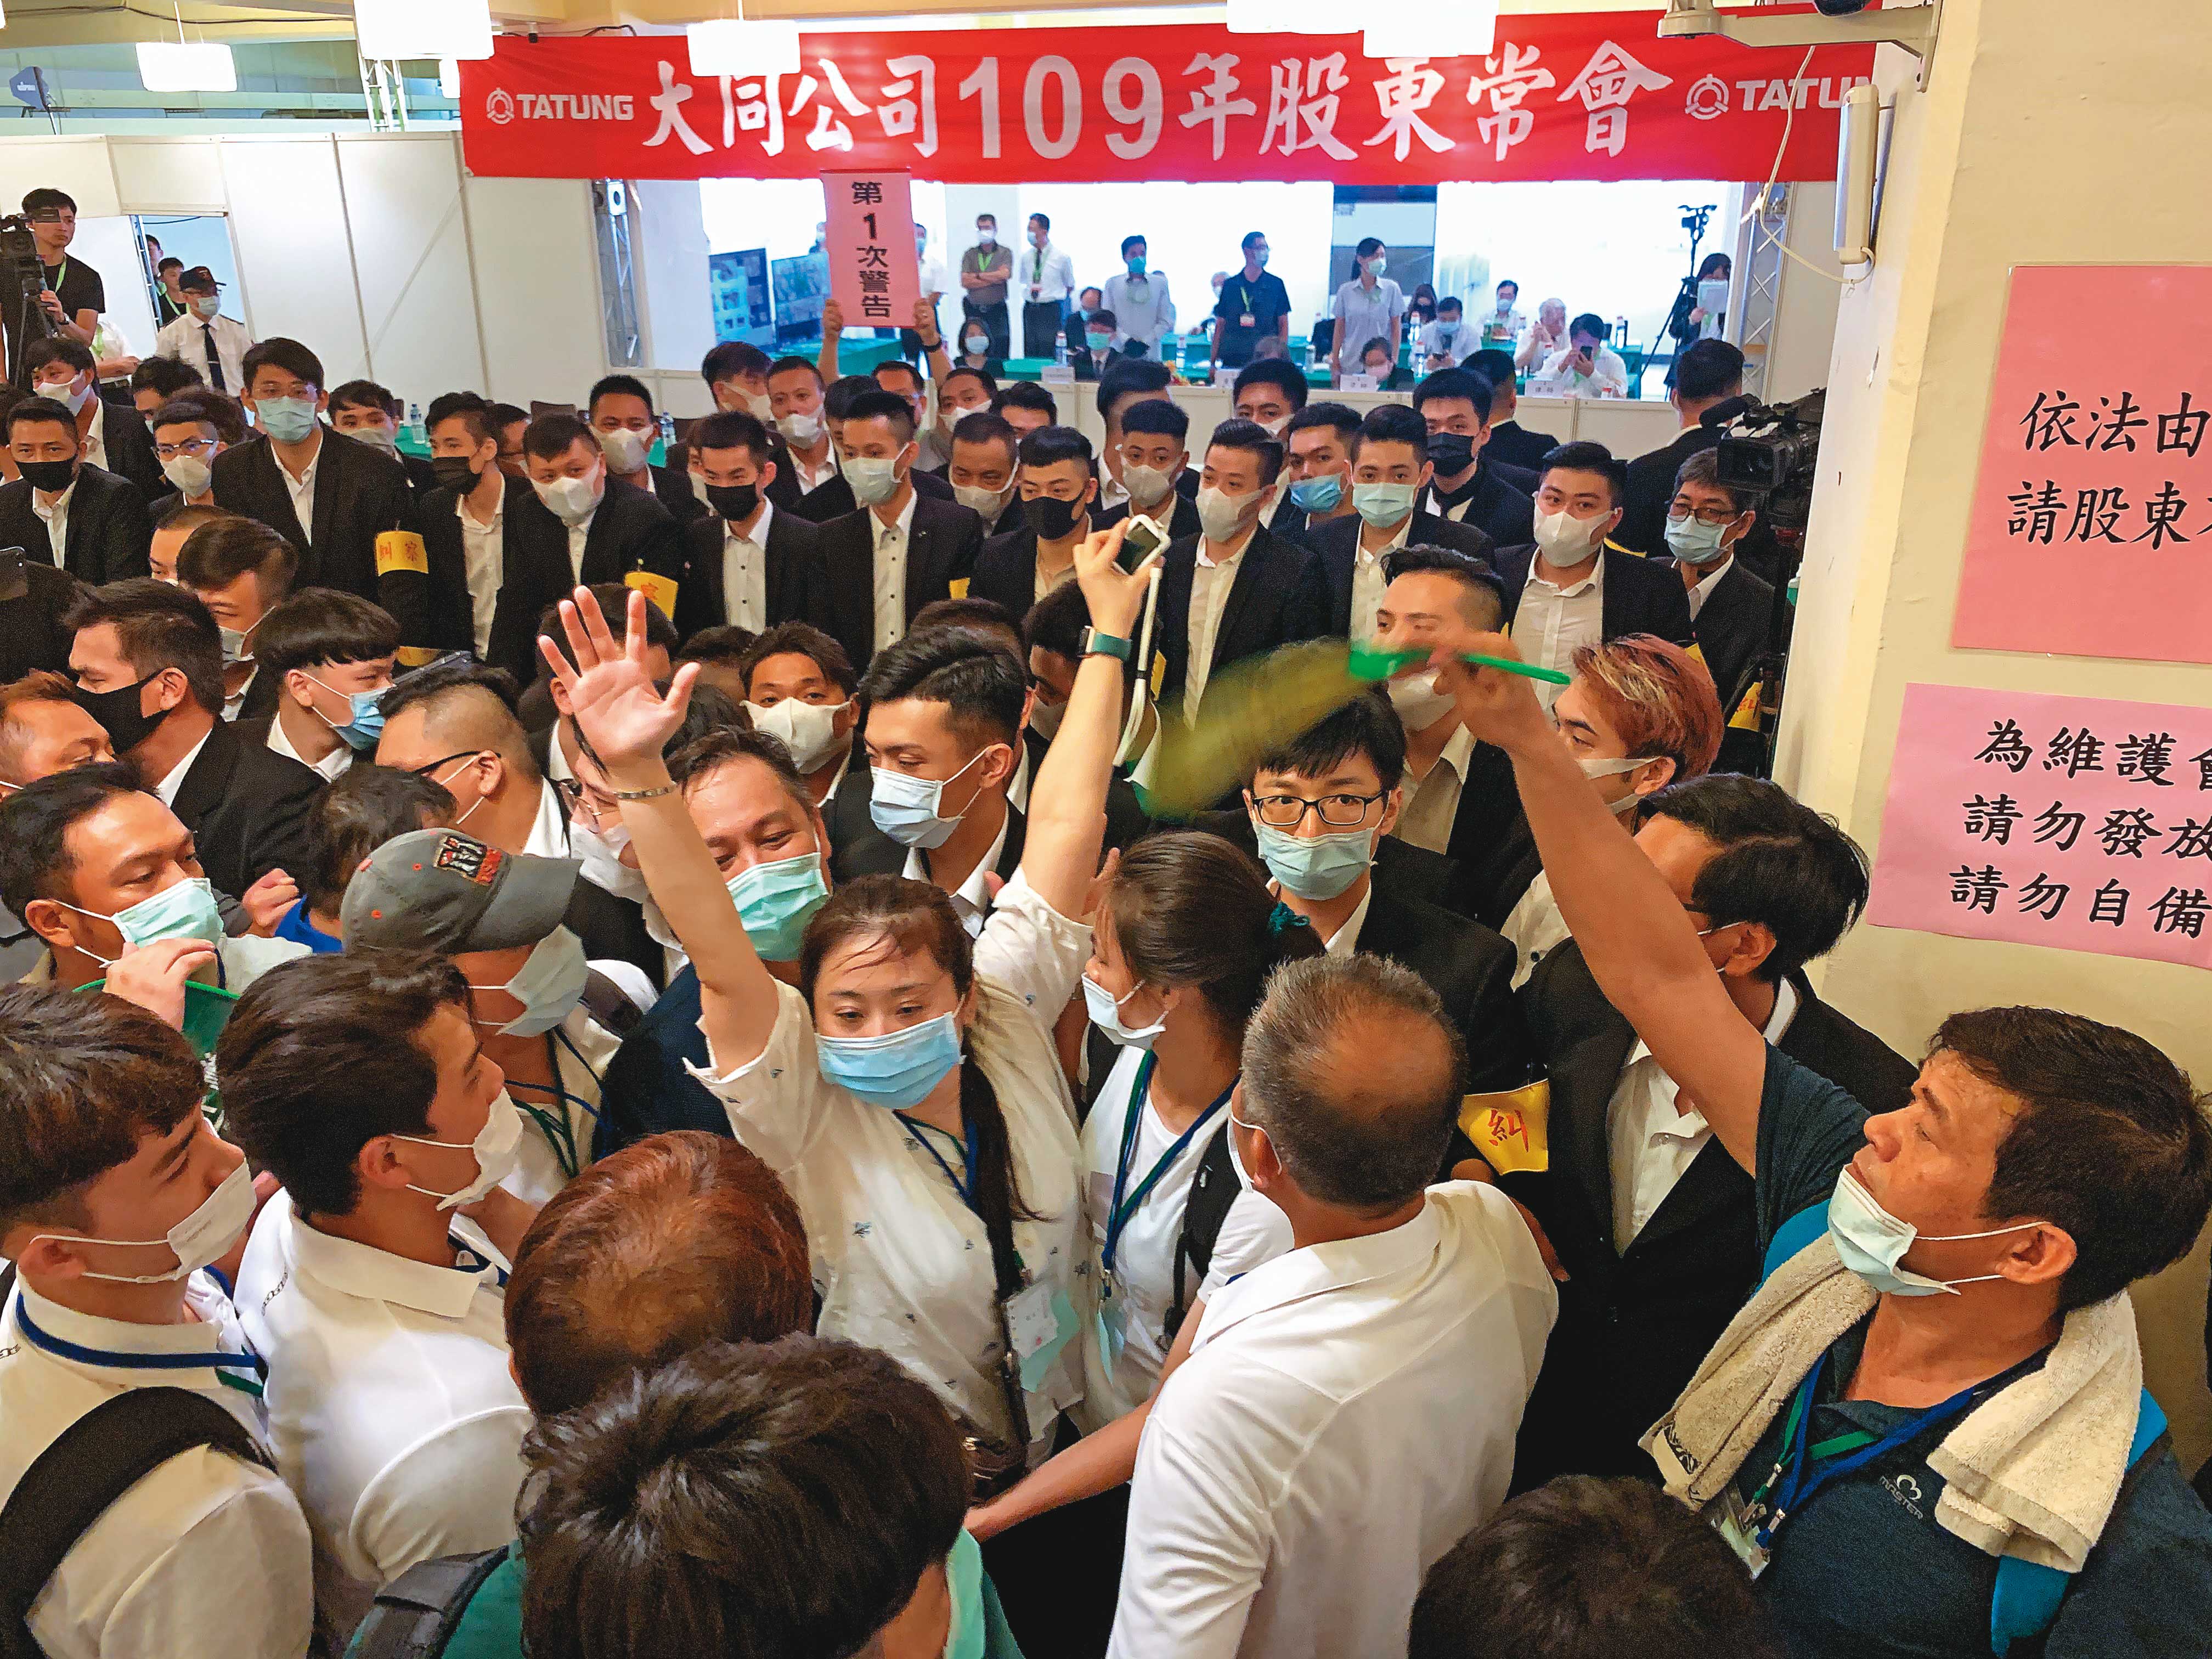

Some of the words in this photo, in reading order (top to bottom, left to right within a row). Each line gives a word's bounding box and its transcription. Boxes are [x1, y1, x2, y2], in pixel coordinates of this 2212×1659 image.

[516, 94, 634, 121] TATUNG
[642, 40, 1673, 161] 大同公司109年股東常會
[851, 181, 891, 318] 第1次警告
[2019, 390, 2211, 458] 依法由
[1962, 793, 2212, 862] 請勿發放
[1949, 865, 2212, 939] 請勿自備
[1487, 1109, 1529, 1153] 糾
[1879, 1476, 1923, 1520] MASTER
